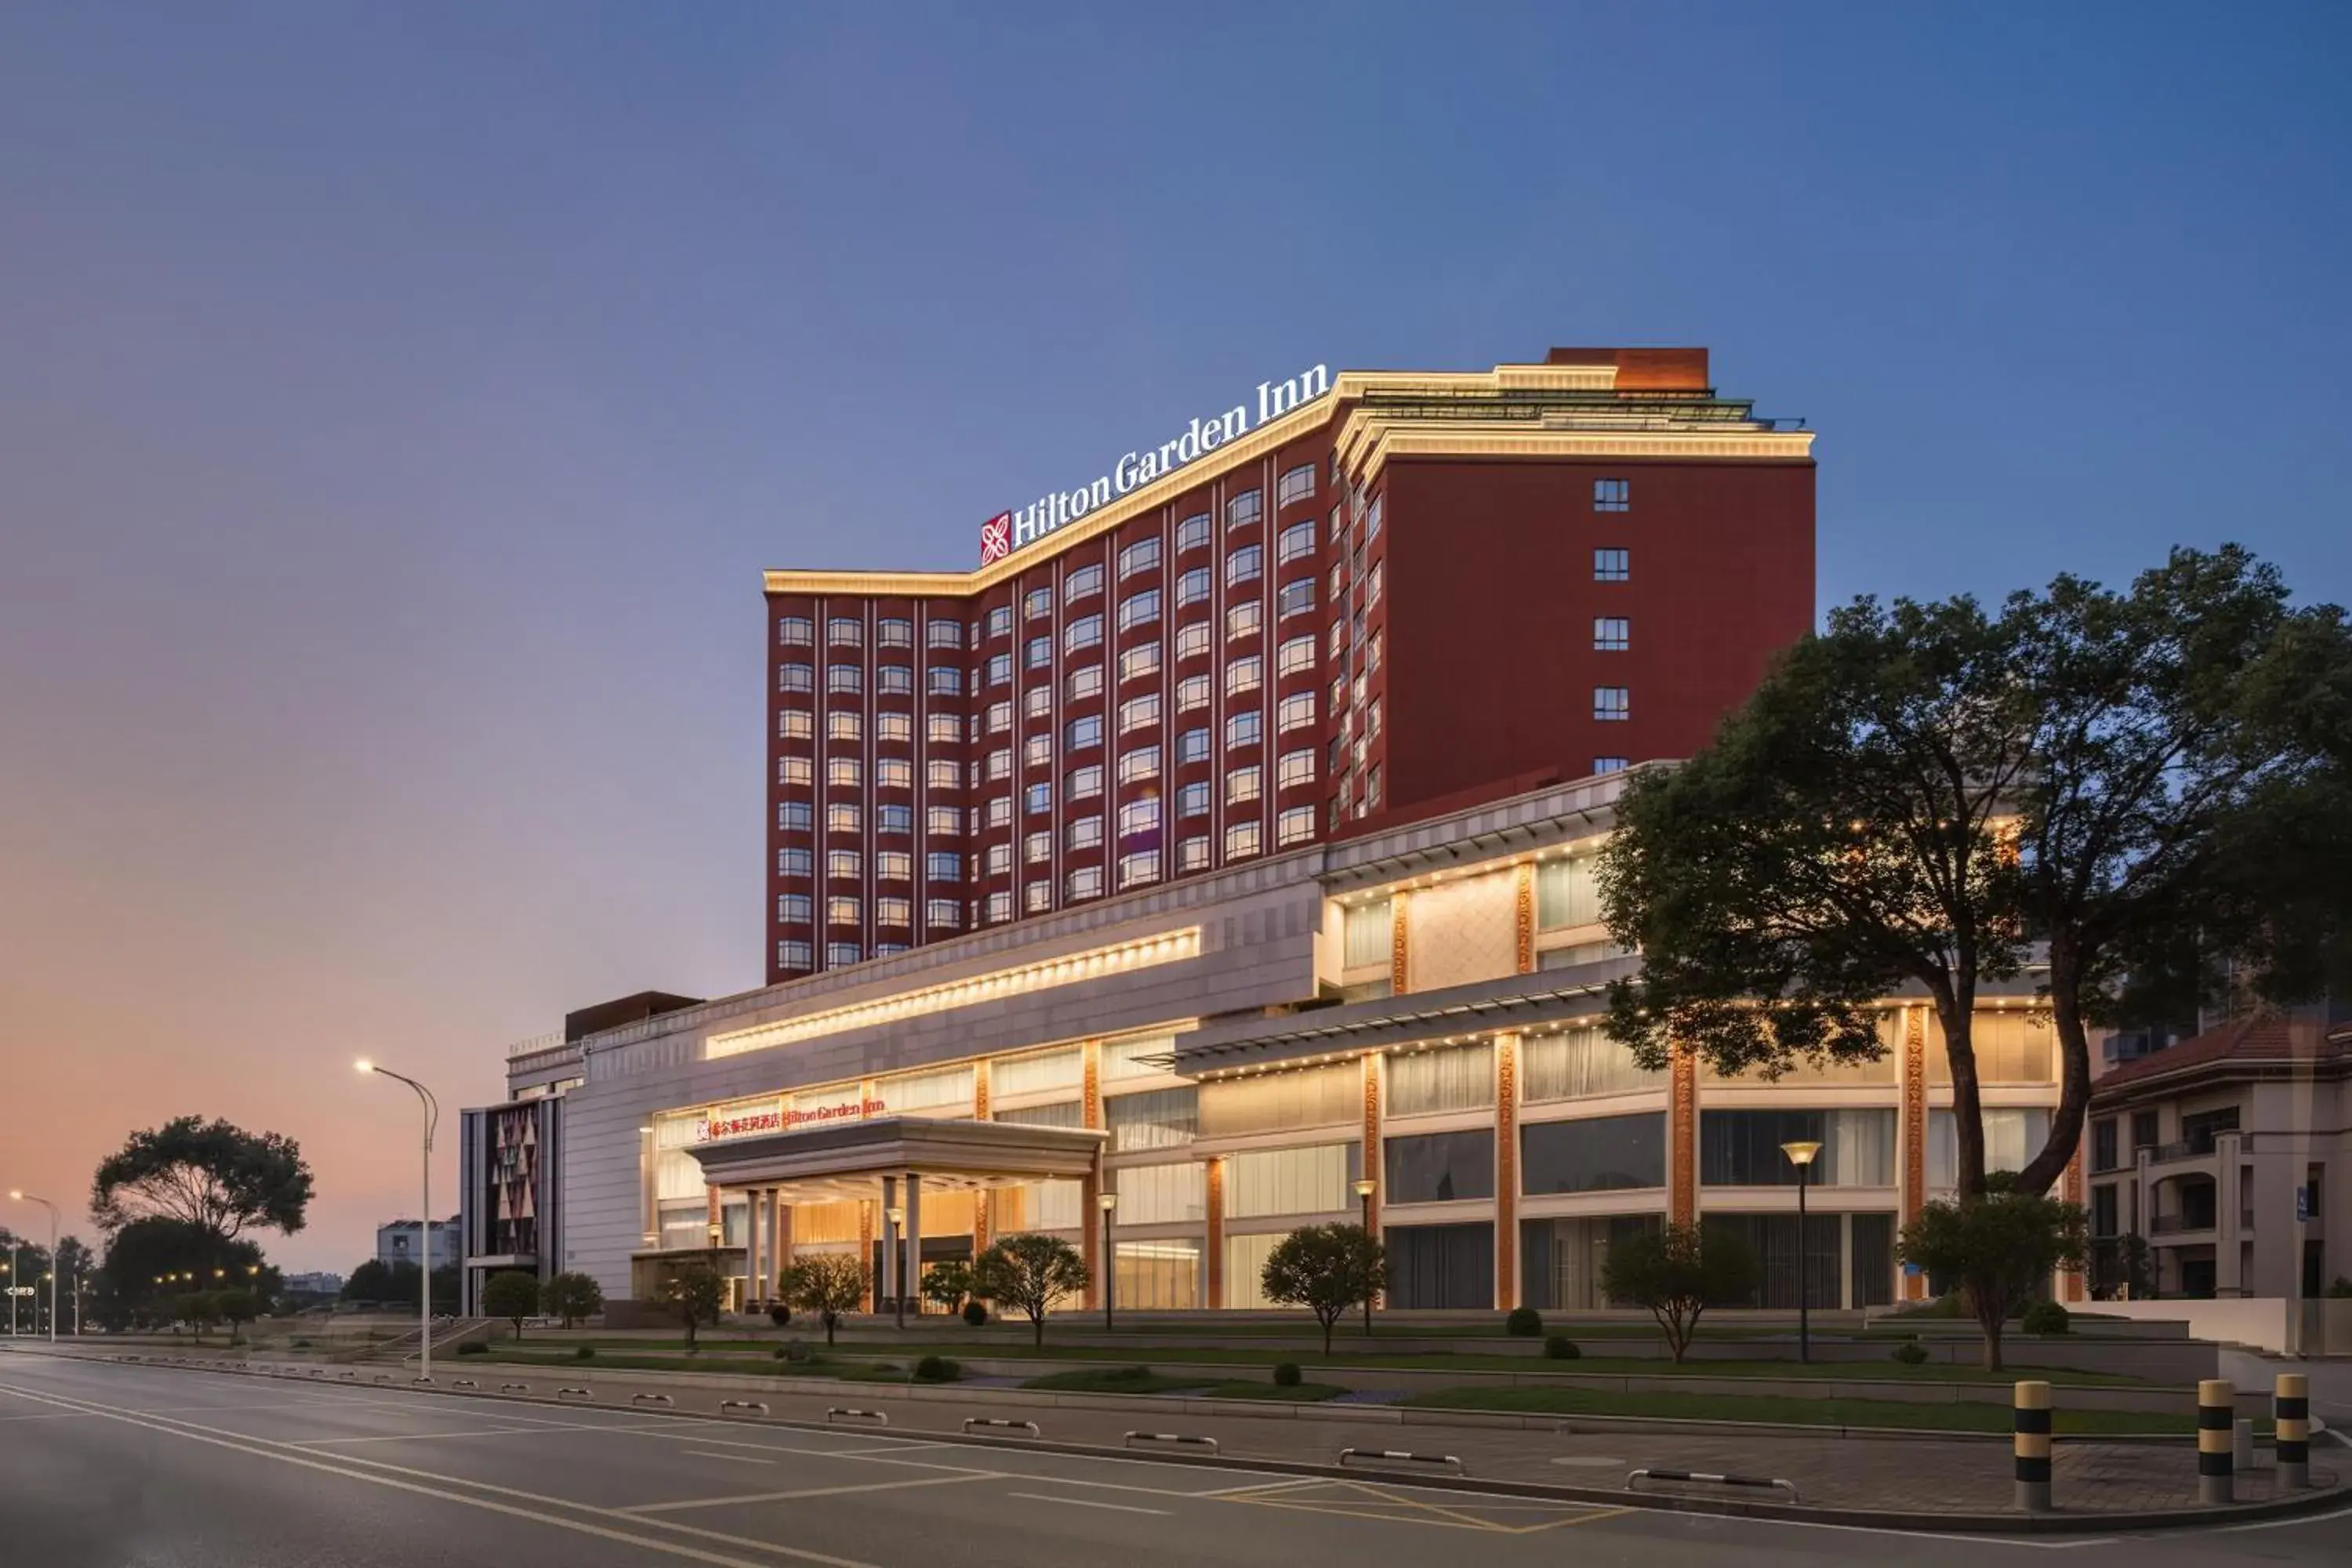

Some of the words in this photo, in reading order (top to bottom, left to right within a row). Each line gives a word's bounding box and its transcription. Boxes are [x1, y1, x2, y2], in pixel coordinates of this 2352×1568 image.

[1014, 477, 1110, 547] Hilton
[1116, 405, 1248, 493] Garden
[1257, 364, 1329, 425] Inn
[782, 1109, 815, 1127] Hilton
[818, 1103, 859, 1120] Garden
[862, 1099, 884, 1114] Inn
